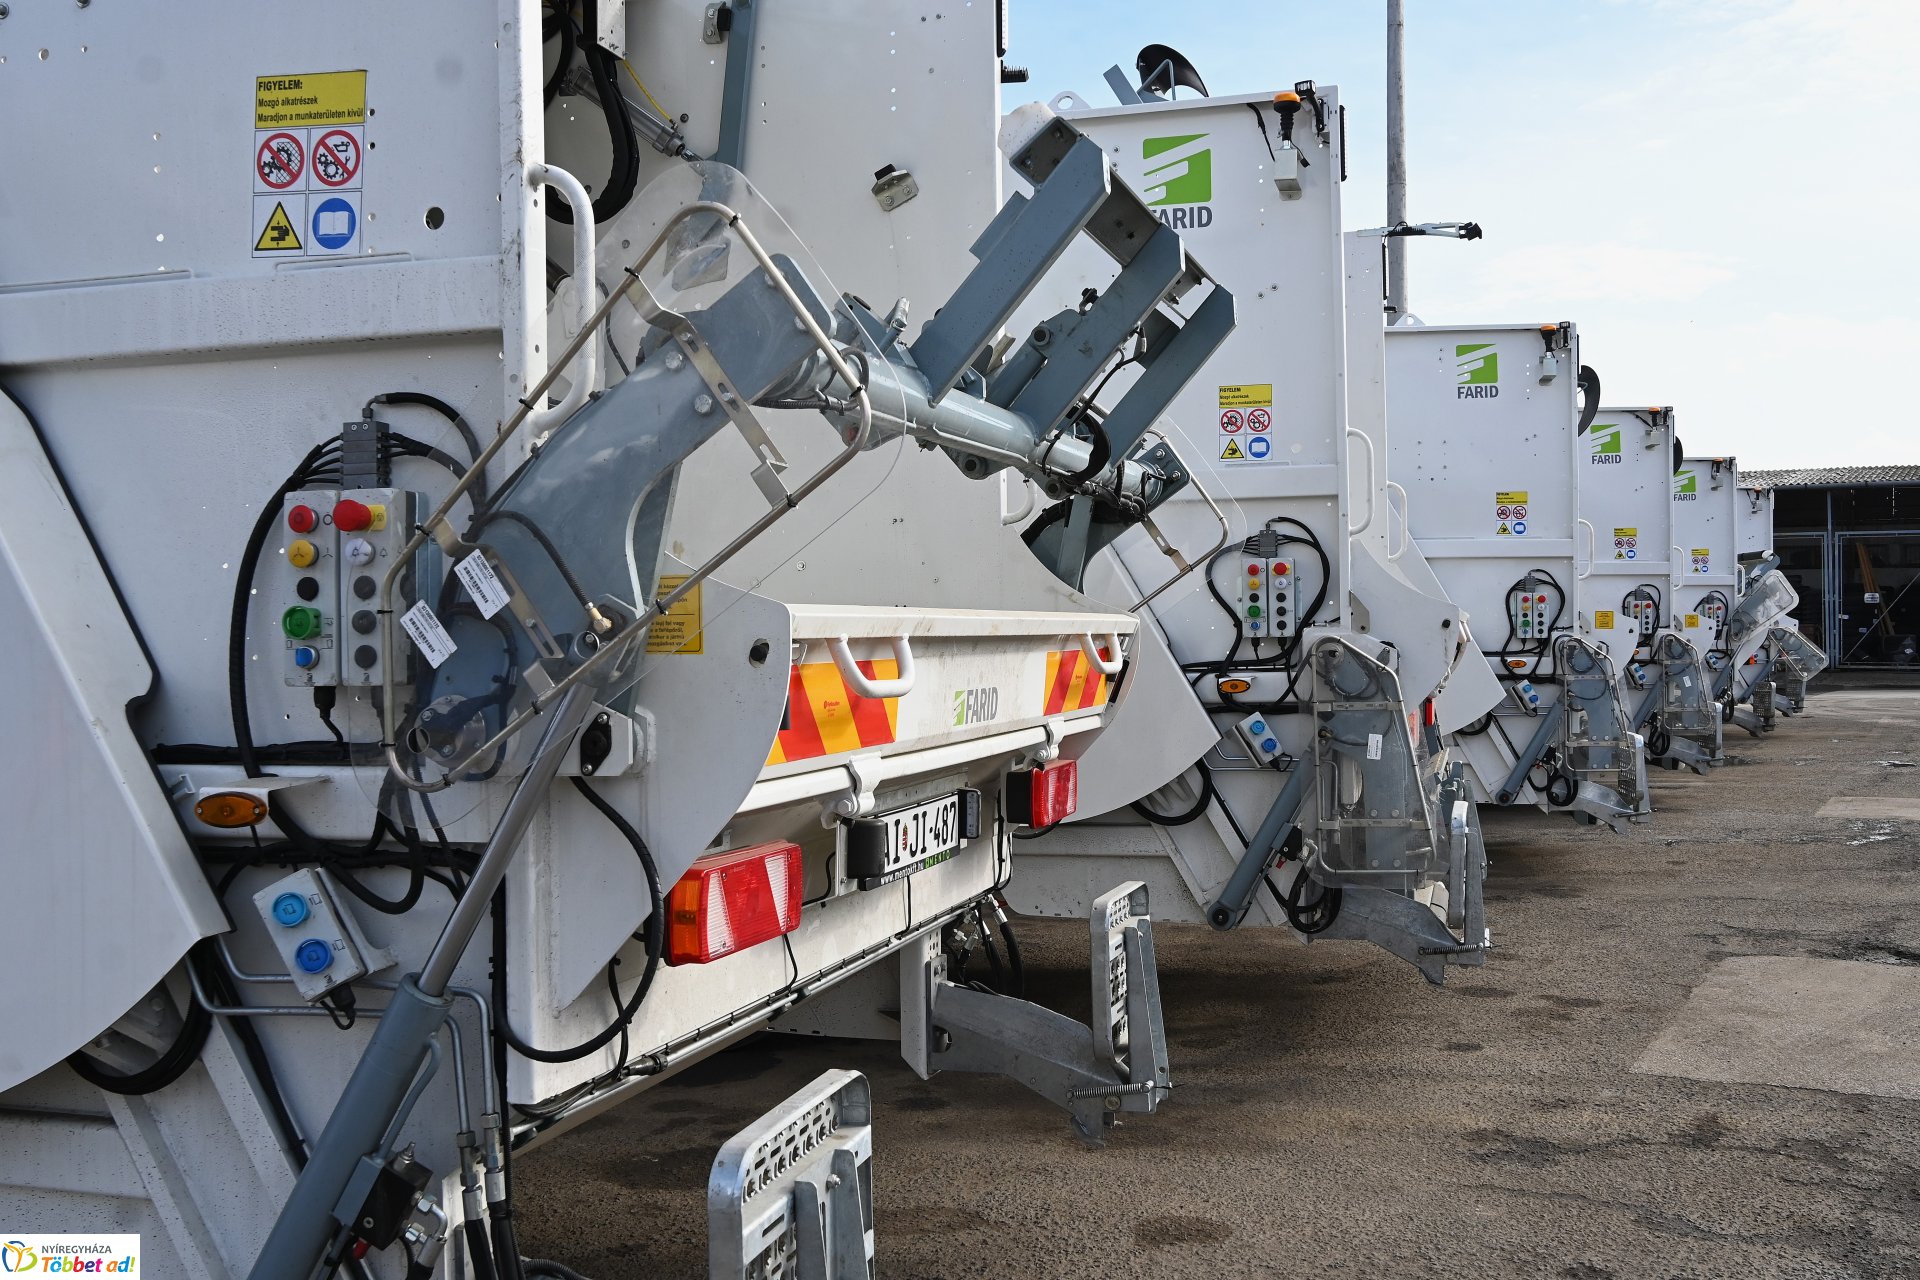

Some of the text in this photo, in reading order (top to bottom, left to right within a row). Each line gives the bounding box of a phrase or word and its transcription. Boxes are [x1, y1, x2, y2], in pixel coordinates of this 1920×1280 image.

[258, 79, 303, 91] FIGYELEM:
[258, 96, 318, 109] Mozgó alkatrészek
[257, 113, 288, 124] Maradjon
[1457, 385, 1499, 399] FARID
[1591, 454, 1622, 465] FARID
[1673, 493, 1697, 502] FARID
[965, 686, 999, 725] FARID
